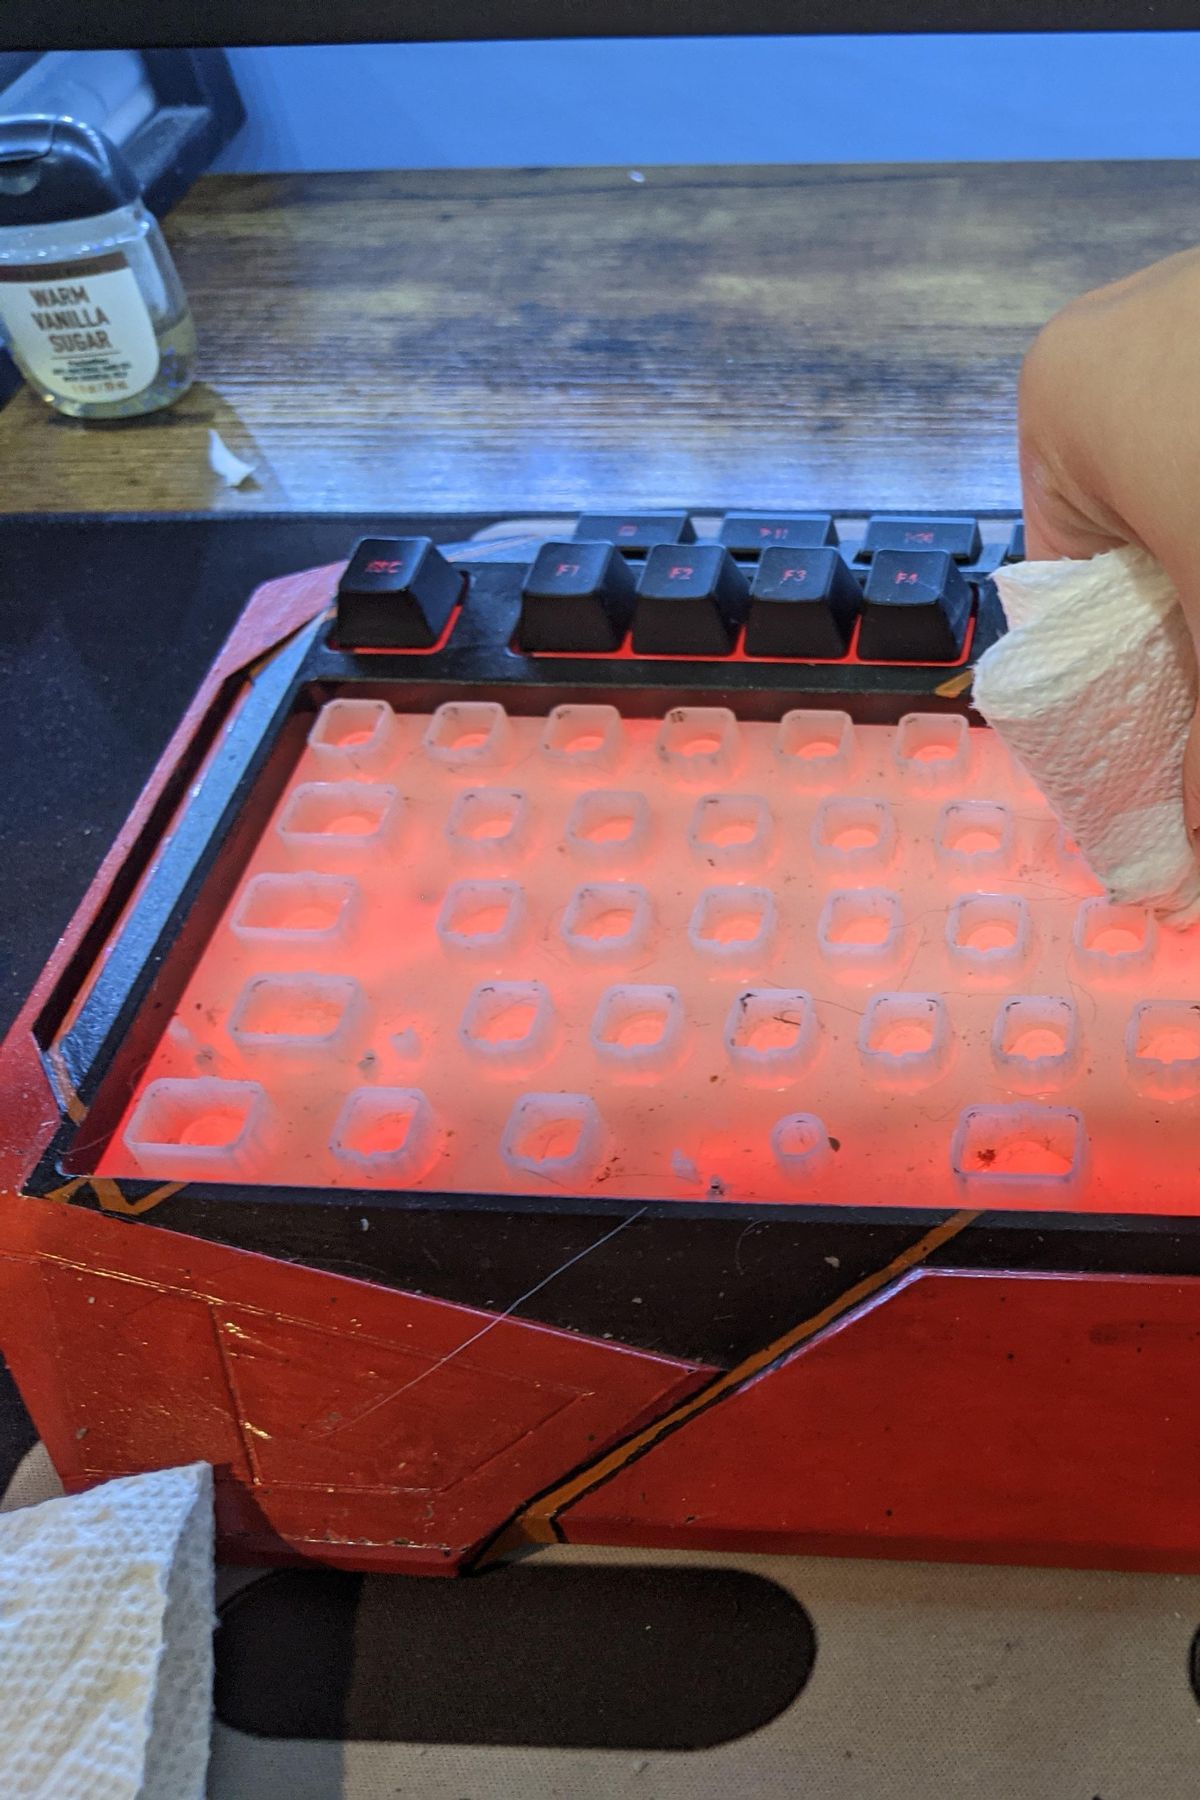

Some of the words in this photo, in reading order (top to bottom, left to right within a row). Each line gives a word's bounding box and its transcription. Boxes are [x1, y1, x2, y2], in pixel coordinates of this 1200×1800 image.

[28, 286, 90, 308] WARM
[31, 306, 110, 331] VANILLA
[48, 330, 112, 353] SUGAR
[669, 567, 694, 579] F2
[783, 569, 808, 581] F3
[896, 572, 918, 584] F4
